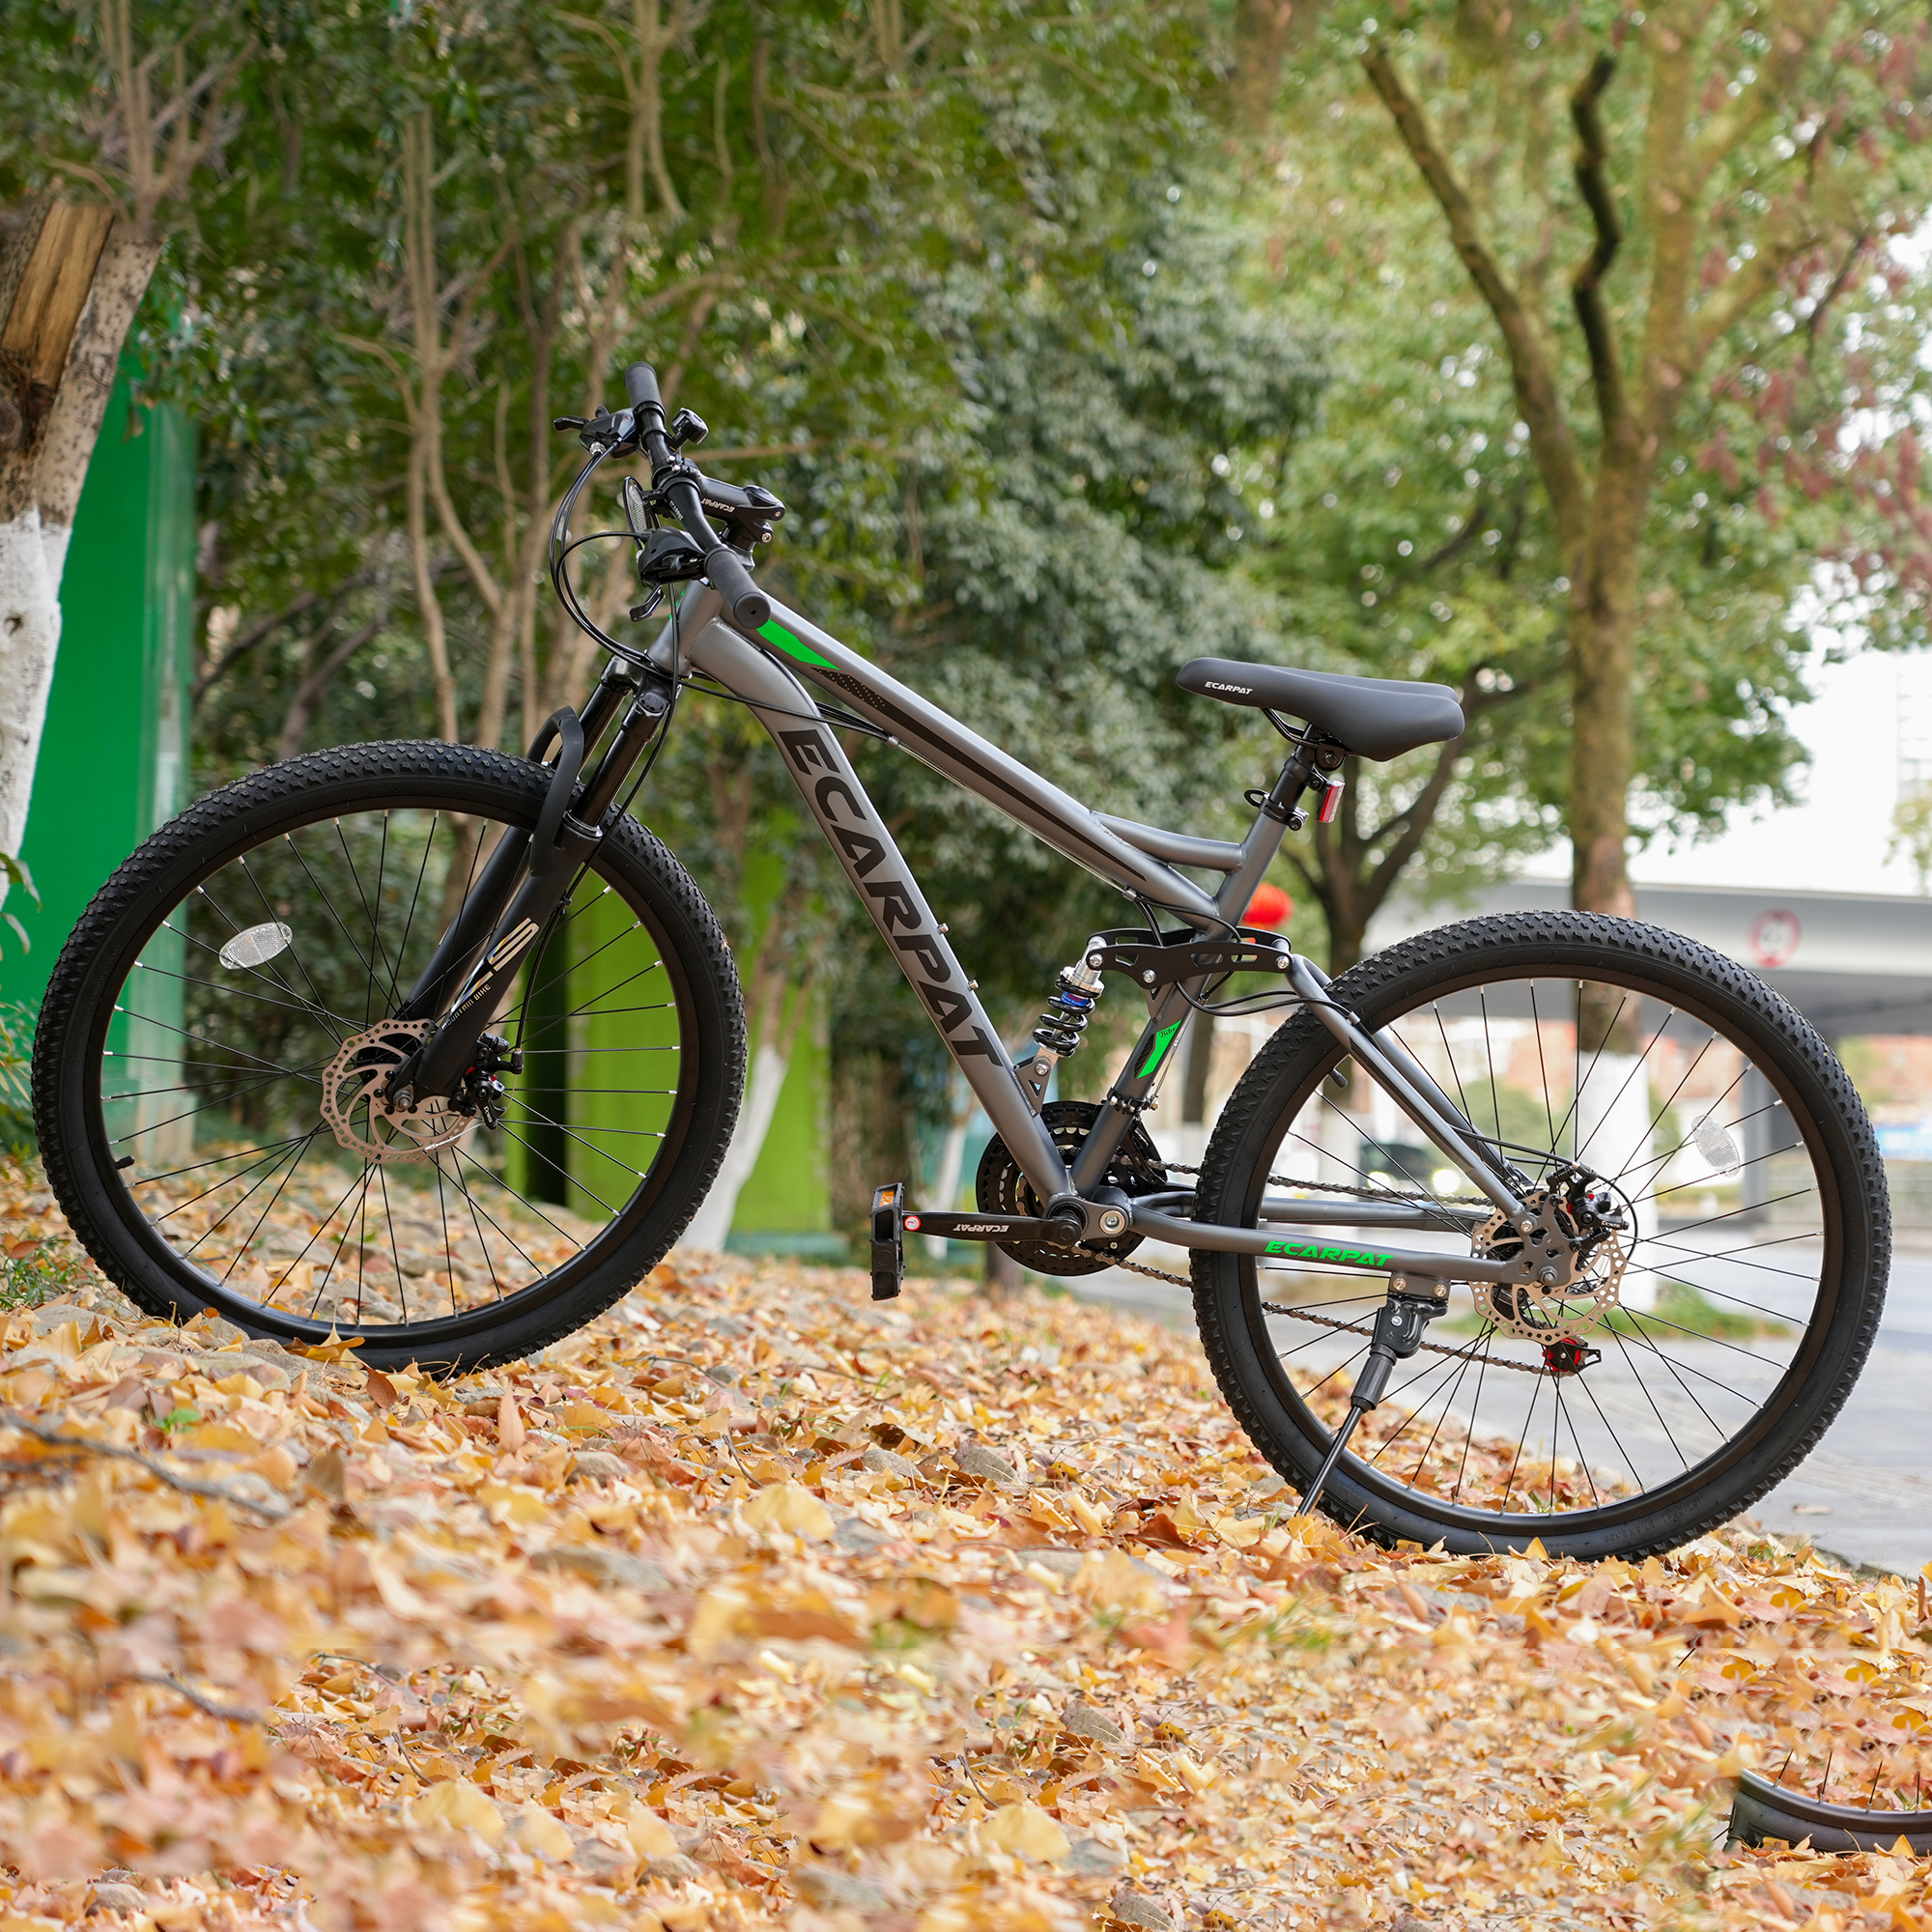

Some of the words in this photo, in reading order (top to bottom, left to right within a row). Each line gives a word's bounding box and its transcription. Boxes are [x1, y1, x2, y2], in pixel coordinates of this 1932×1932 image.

[700, 497, 736, 513] ECARPAT
[1205, 681, 1254, 695] ECARPAT
[778, 729, 1004, 1066] ECARPAT
[952, 1222, 1010, 1234] ECARPAT
[1264, 1240, 1394, 1266] ECARPAT
